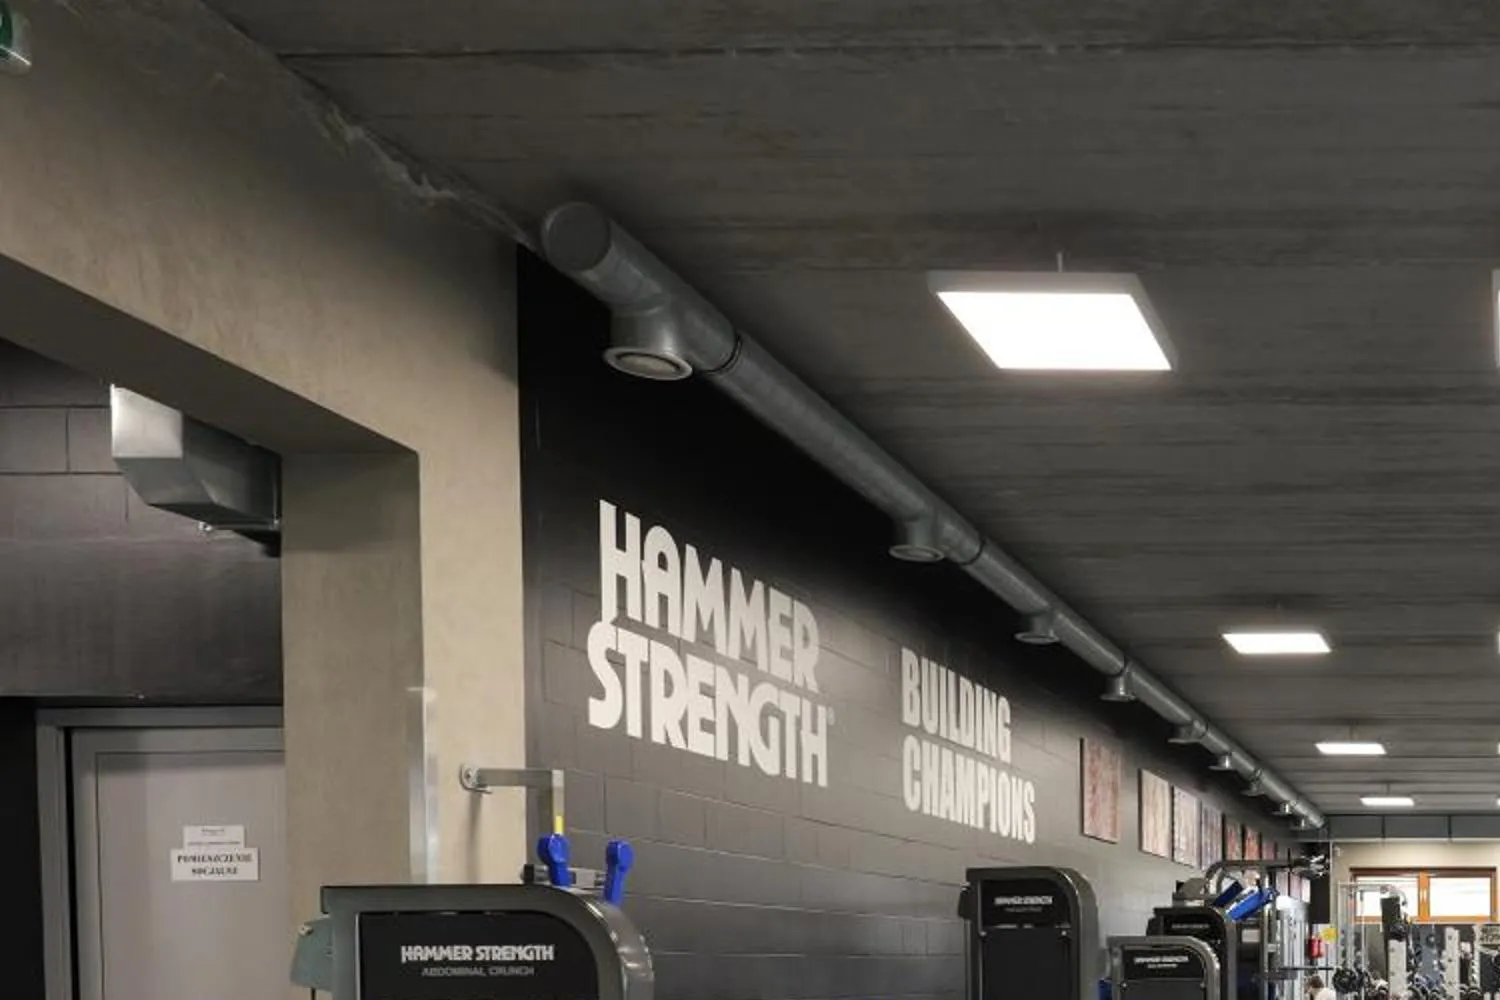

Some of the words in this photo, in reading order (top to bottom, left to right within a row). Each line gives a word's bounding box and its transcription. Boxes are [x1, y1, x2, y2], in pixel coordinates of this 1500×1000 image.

[599, 499, 820, 693] HAMMER
[587, 620, 828, 787] STRENGTH
[902, 647, 1012, 764] BUILDING
[902, 734, 1035, 844] CHAMPIONS
[401, 945, 473, 963] HAMMER
[475, 944, 555, 961] STRENGTH
[422, 966, 486, 976] ABDOMINAL
[489, 966, 534, 975] CRUNCH
